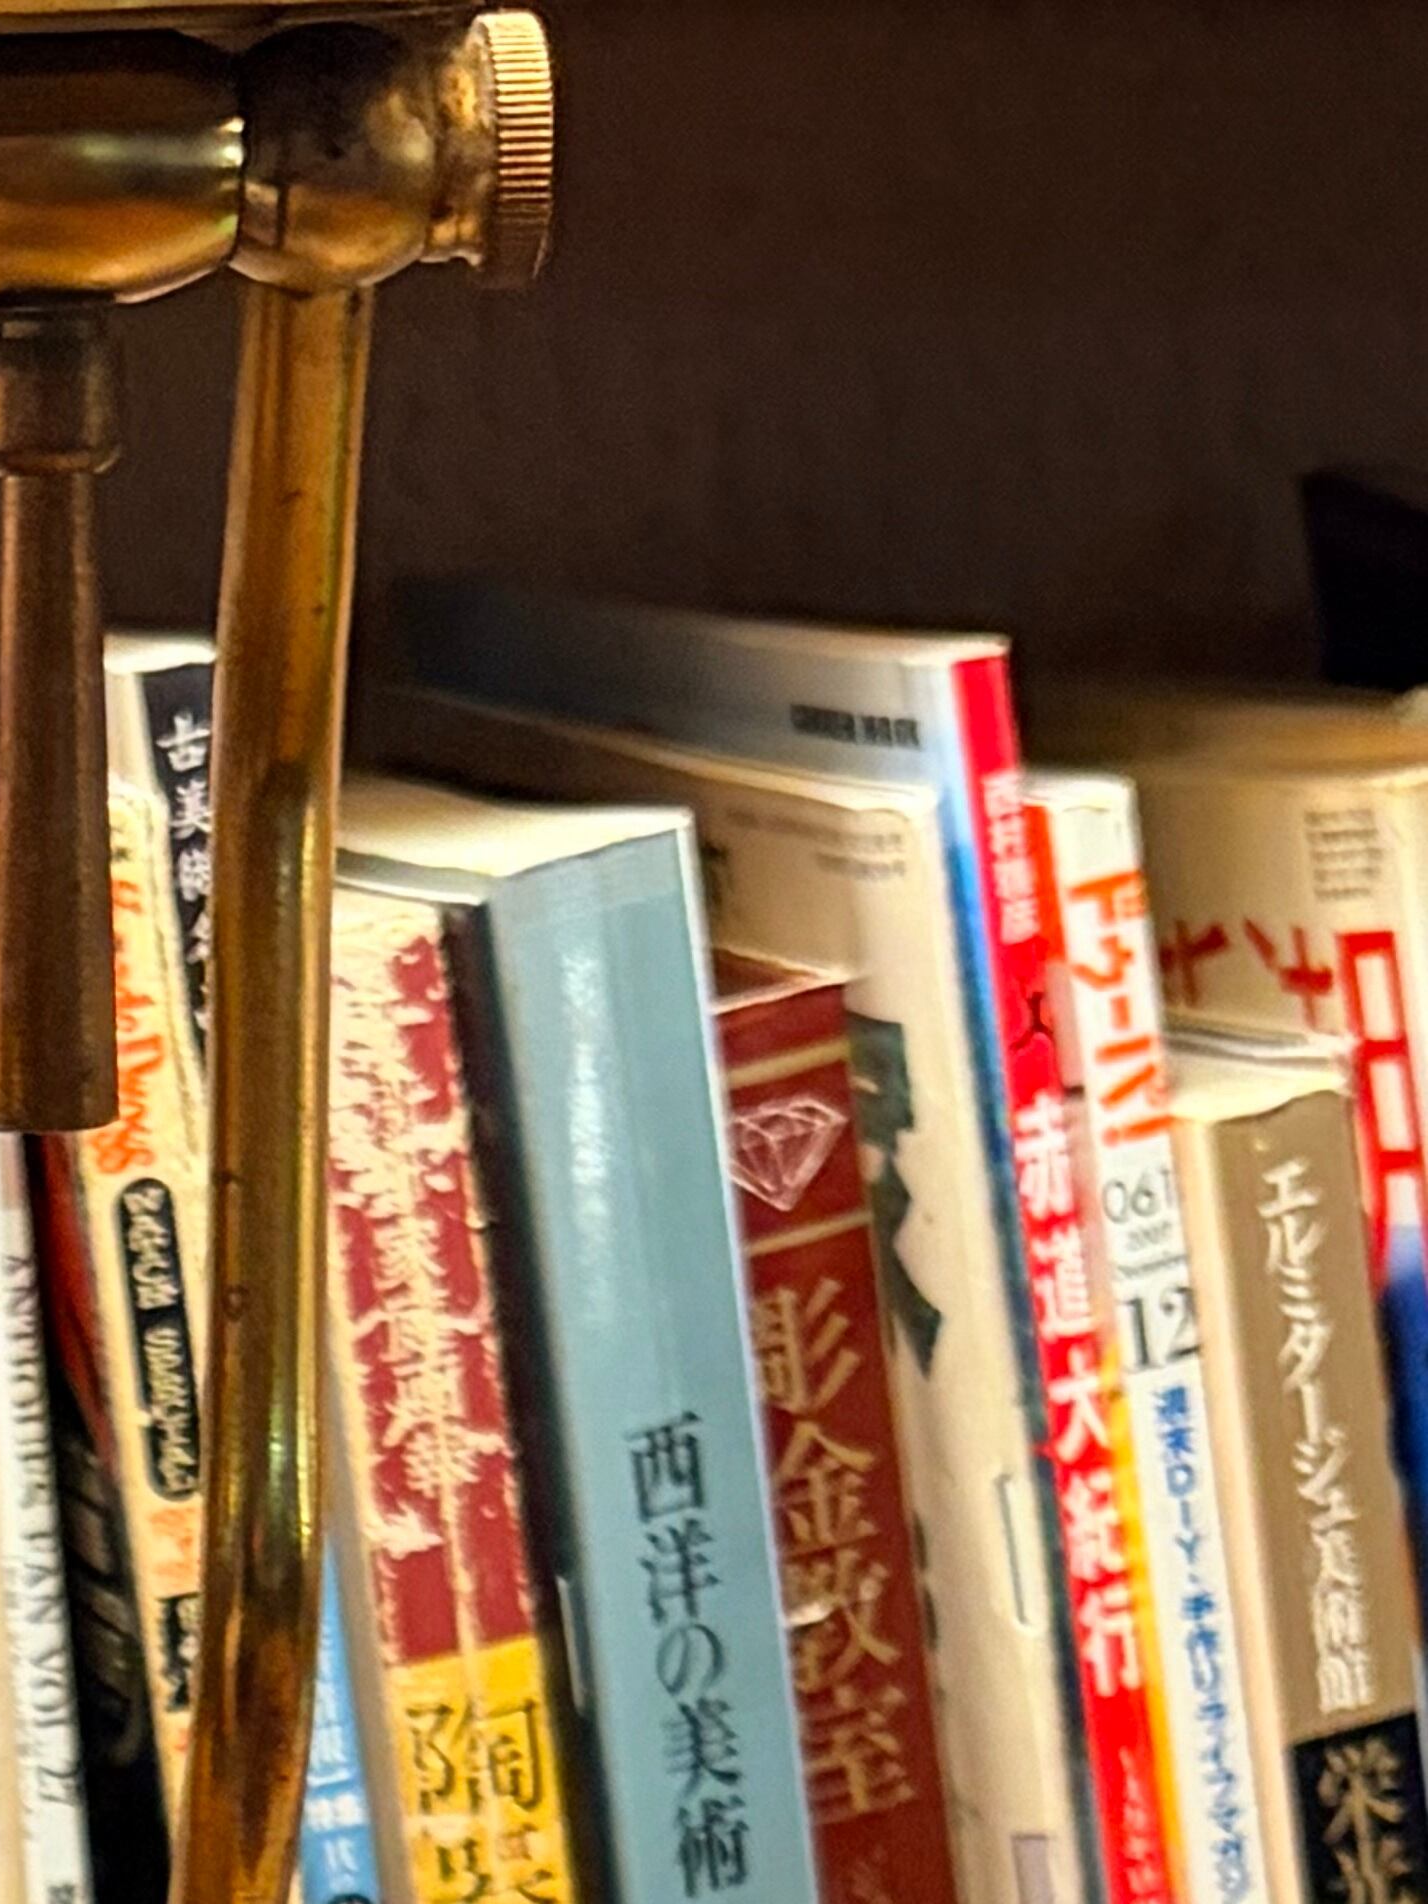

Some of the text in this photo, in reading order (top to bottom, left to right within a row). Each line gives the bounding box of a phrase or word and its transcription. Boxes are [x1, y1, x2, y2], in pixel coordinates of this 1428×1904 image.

[751, 1278, 916, 1825] 彫金教室
[1118, 1285, 1202, 1371] 12
[625, 1409, 751, 1899] 西洋の美術
